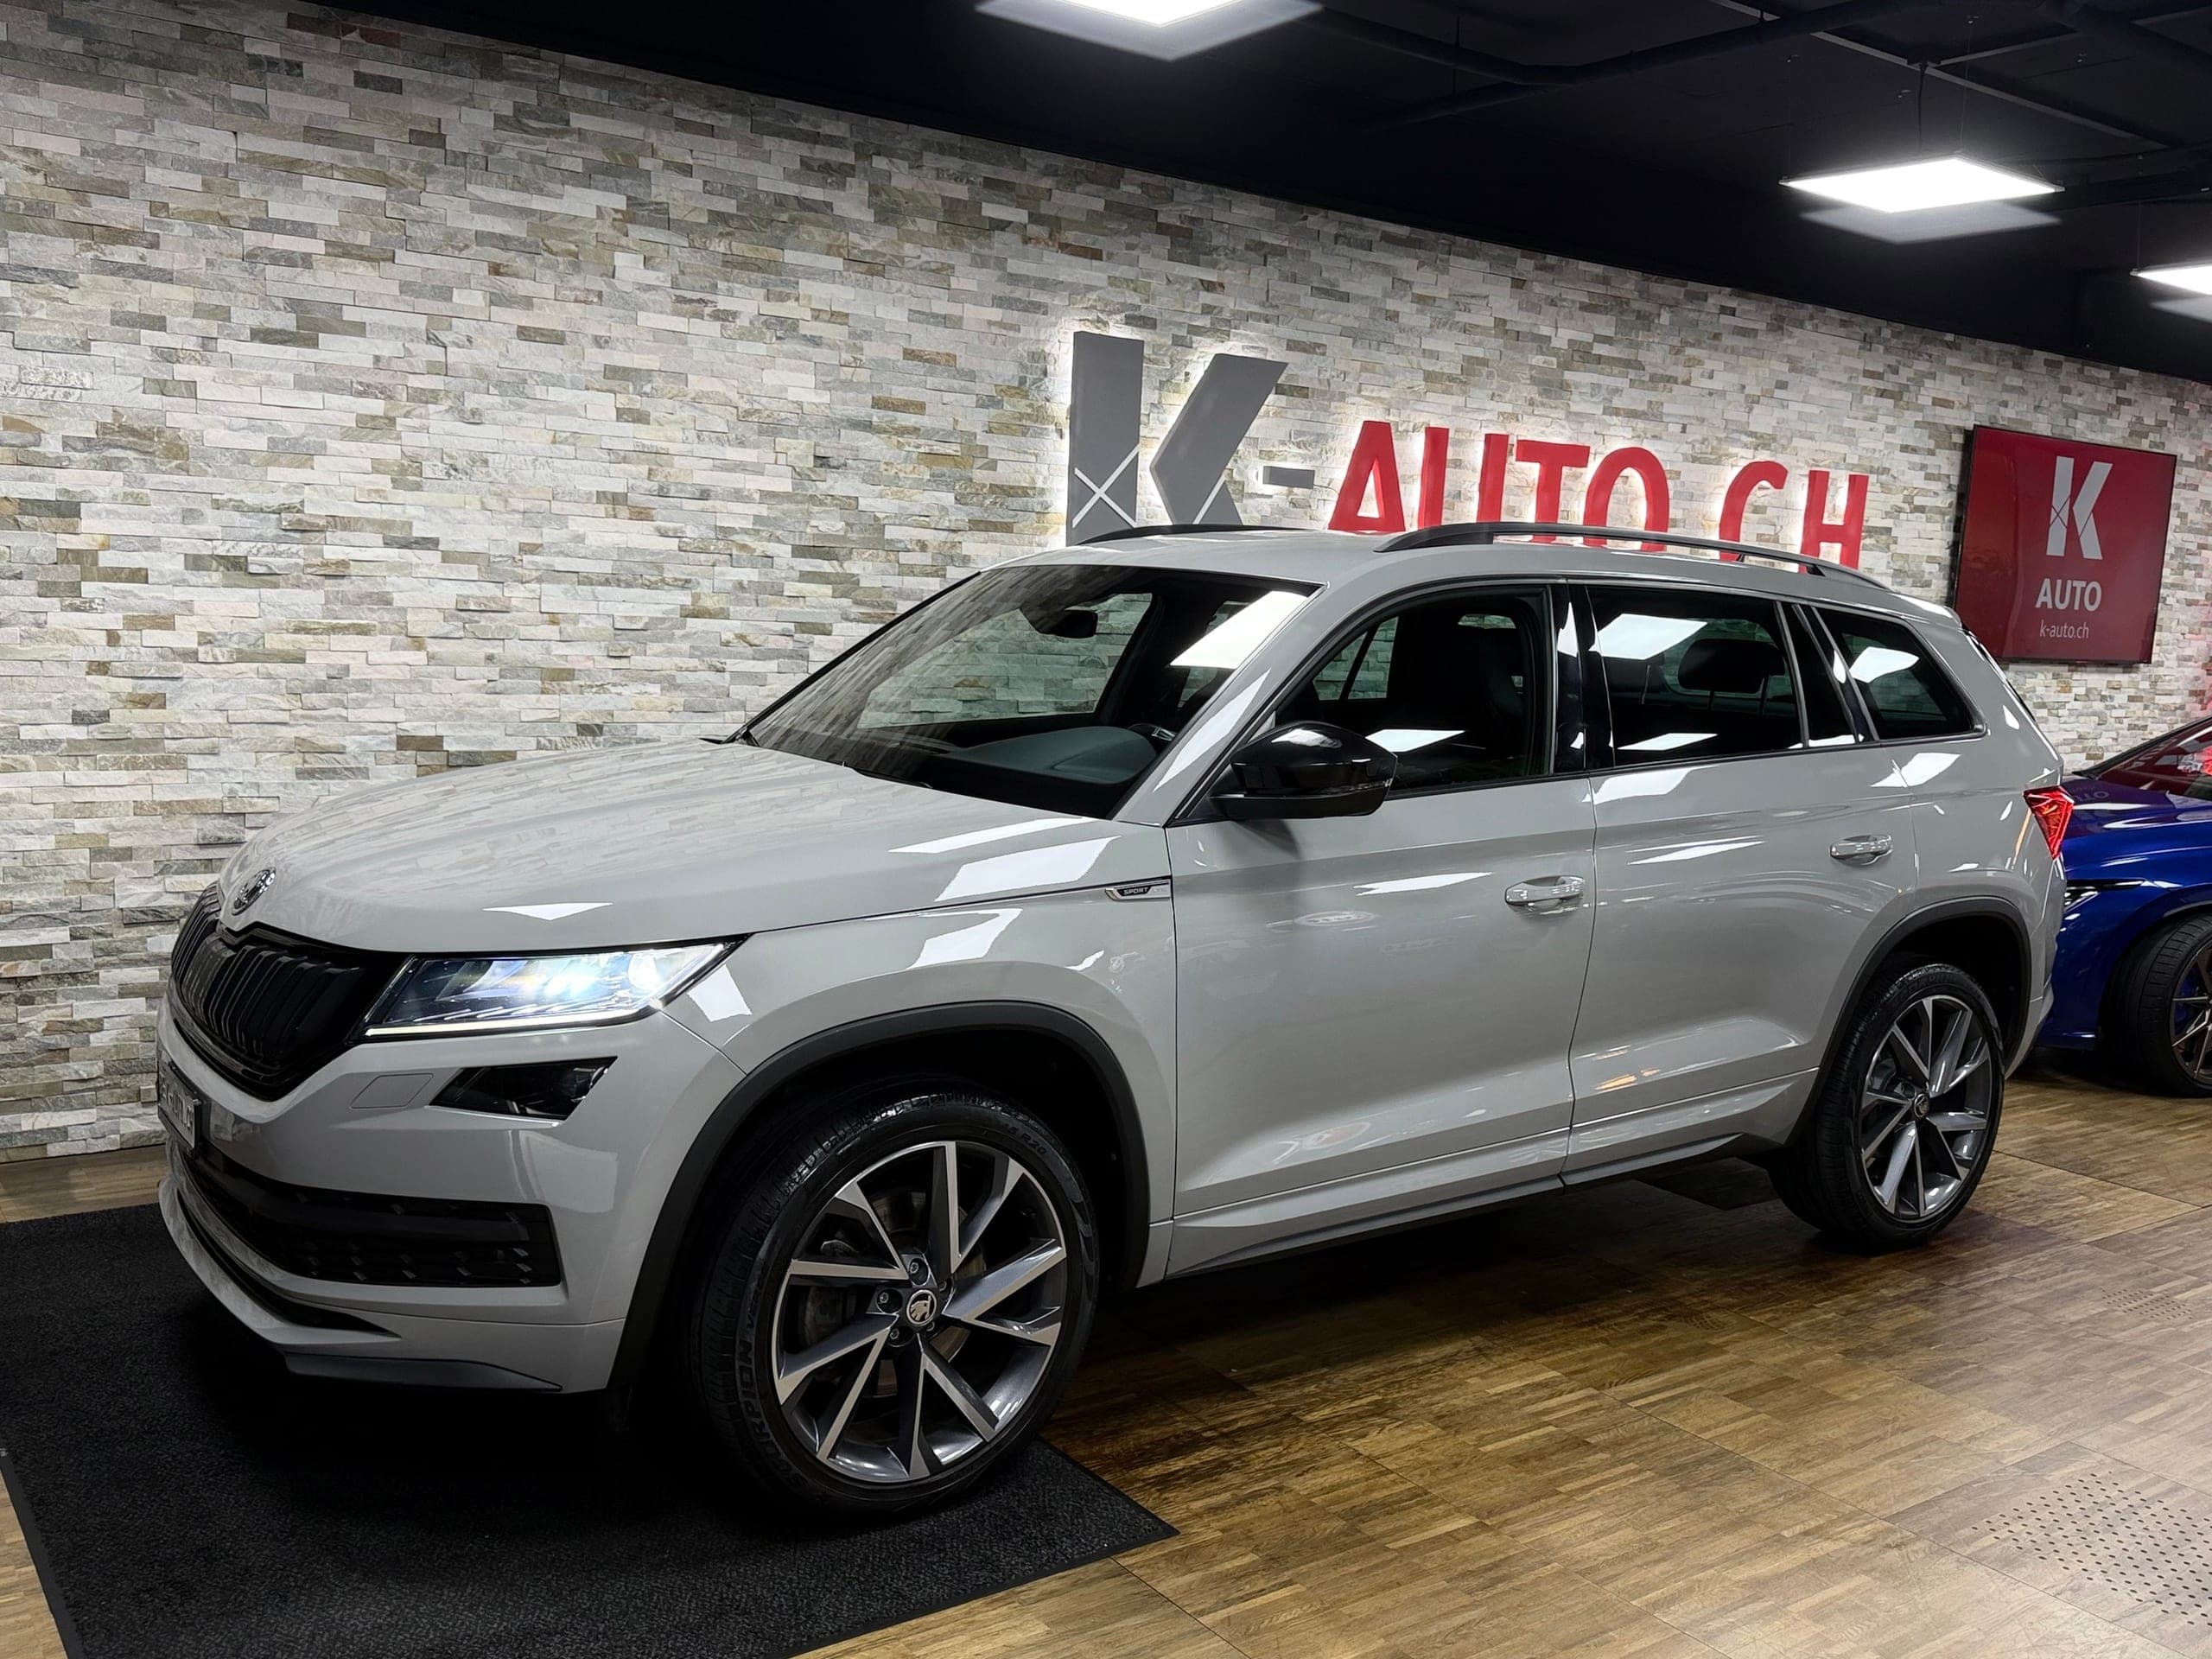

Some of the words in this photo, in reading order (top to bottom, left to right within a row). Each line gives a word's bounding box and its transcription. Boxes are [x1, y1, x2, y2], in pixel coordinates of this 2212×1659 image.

[2046, 455, 2113, 560] K
[2035, 577, 2102, 612] AUTO
[2039, 620, 2089, 639] k-auto.ch
[1123, 887, 1149, 895] SPORT
